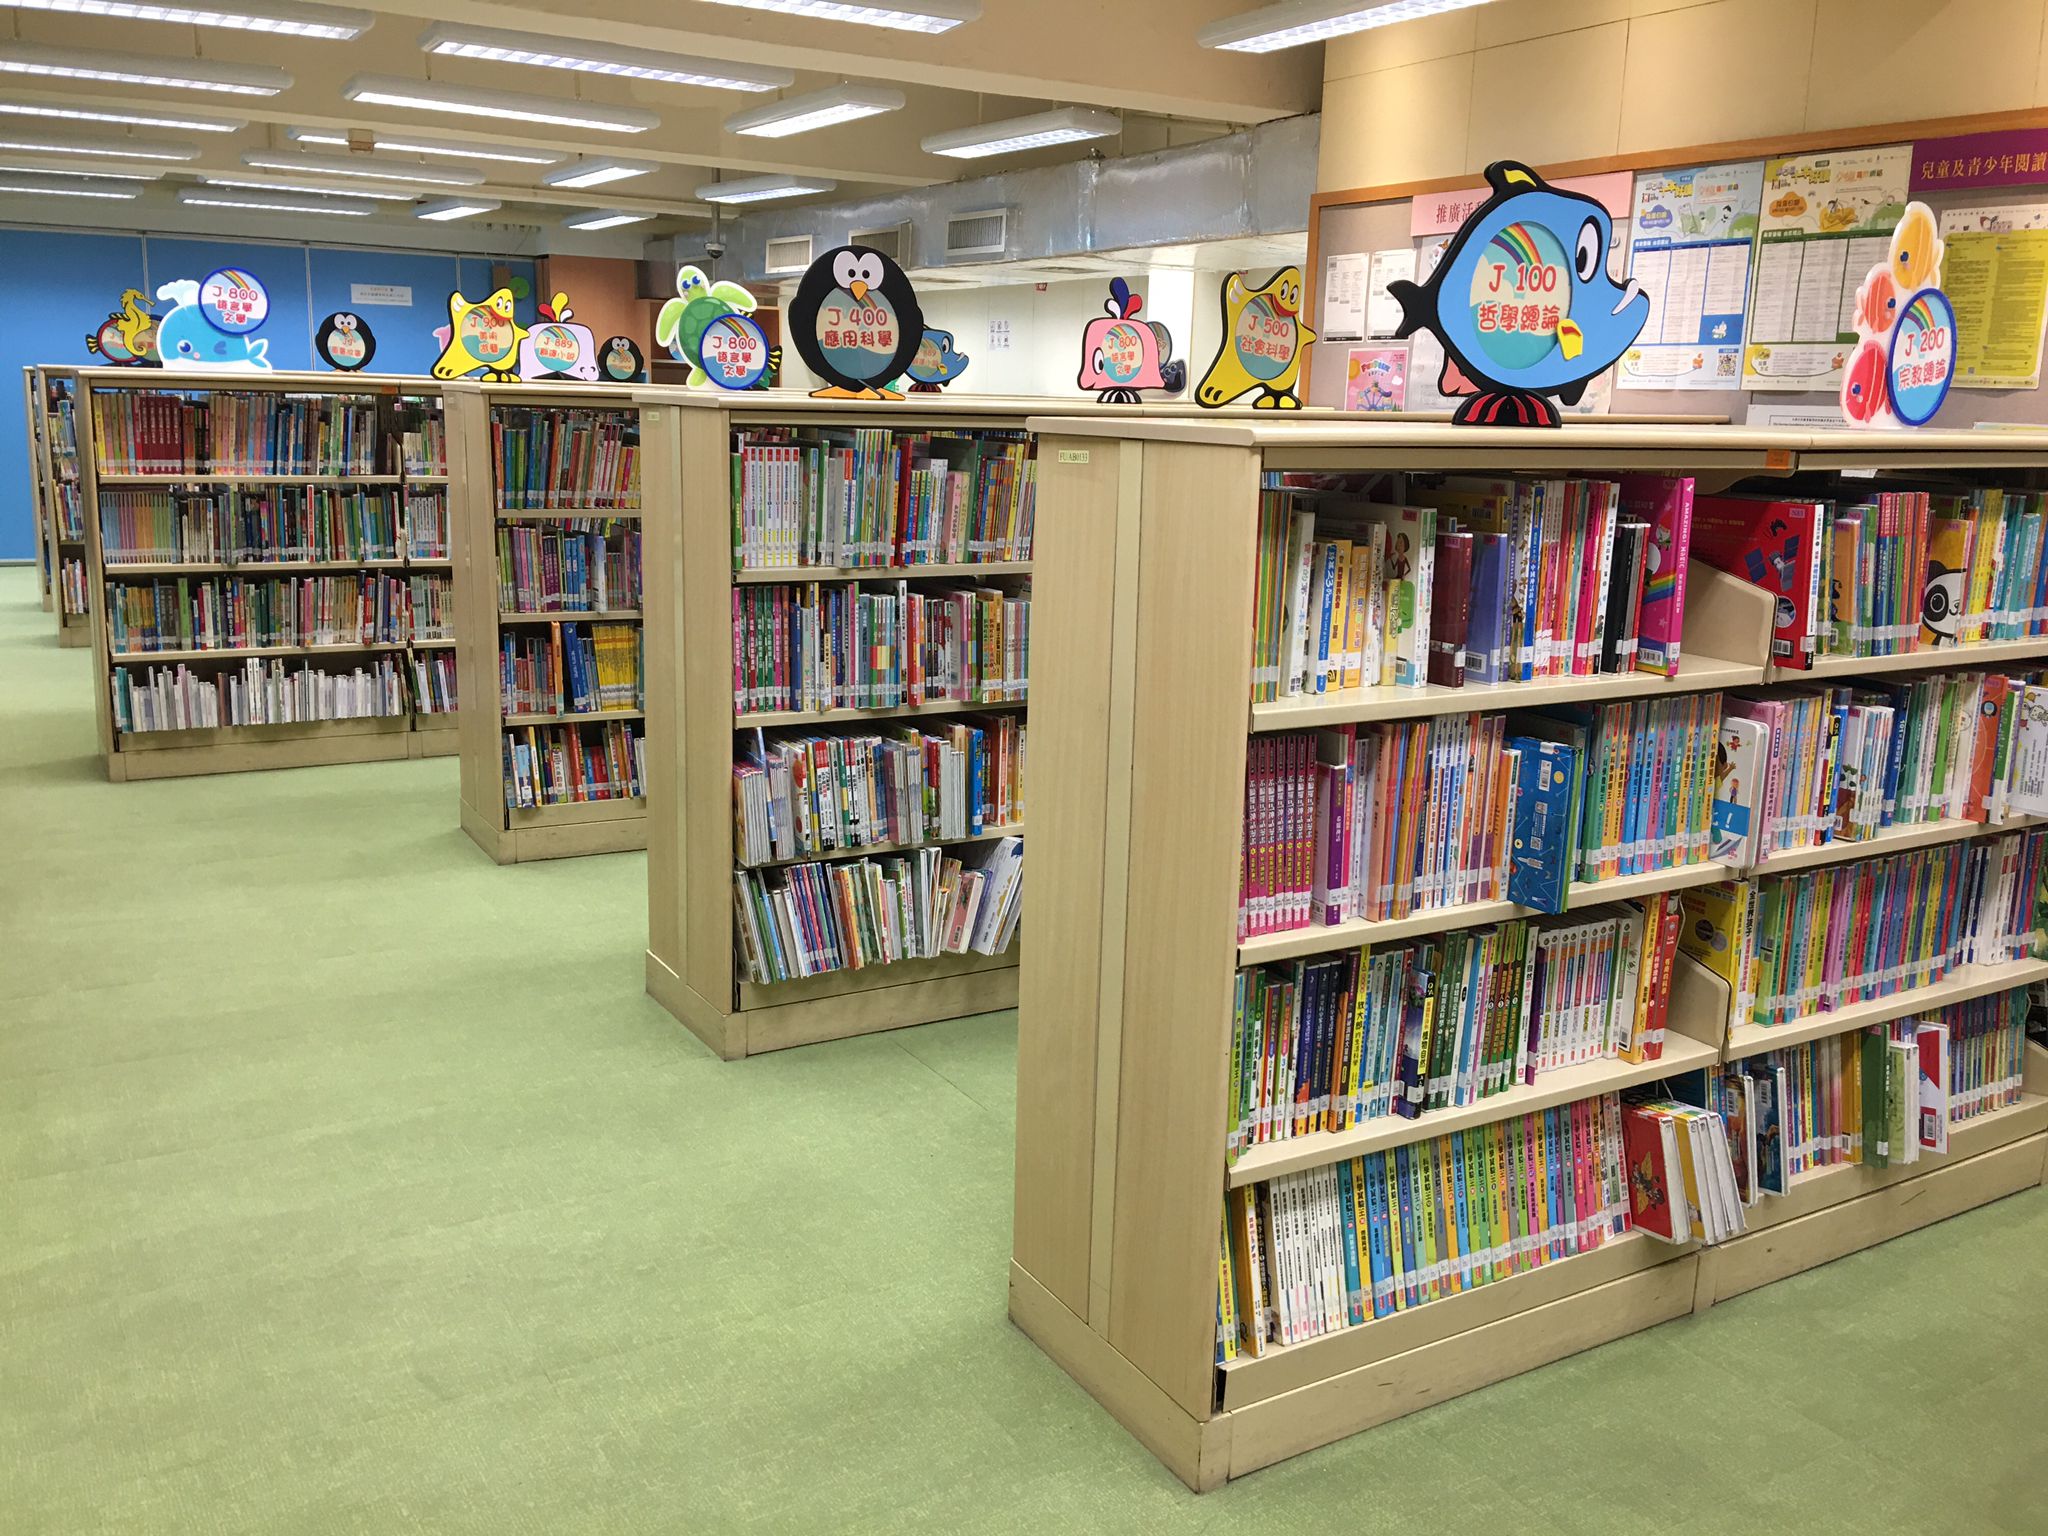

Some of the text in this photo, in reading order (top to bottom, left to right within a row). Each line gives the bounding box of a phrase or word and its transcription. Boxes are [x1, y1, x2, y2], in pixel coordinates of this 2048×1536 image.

[1489, 264, 1556, 293] J 100
[213, 286, 258, 300] J 800
[828, 308, 888, 326] J 400
[1479, 303, 1560, 332] 哲學總論
[1248, 315, 1289, 337] J 500
[544, 337, 573, 348] J 889
[712, 336, 757, 350] J 800
[824, 330, 893, 348] 應用科學
[1108, 335, 1137, 349] J 800
[1905, 326, 1945, 356] J 200
[1240, 335, 1290, 361] 社會科學
[717, 351, 752, 363] 語言學
[1111, 351, 1135, 362] 語言學
[724, 365, 746, 376] 文學
[1116, 364, 1131, 375] 文學
[1899, 359, 1946, 390] 宗教總論
